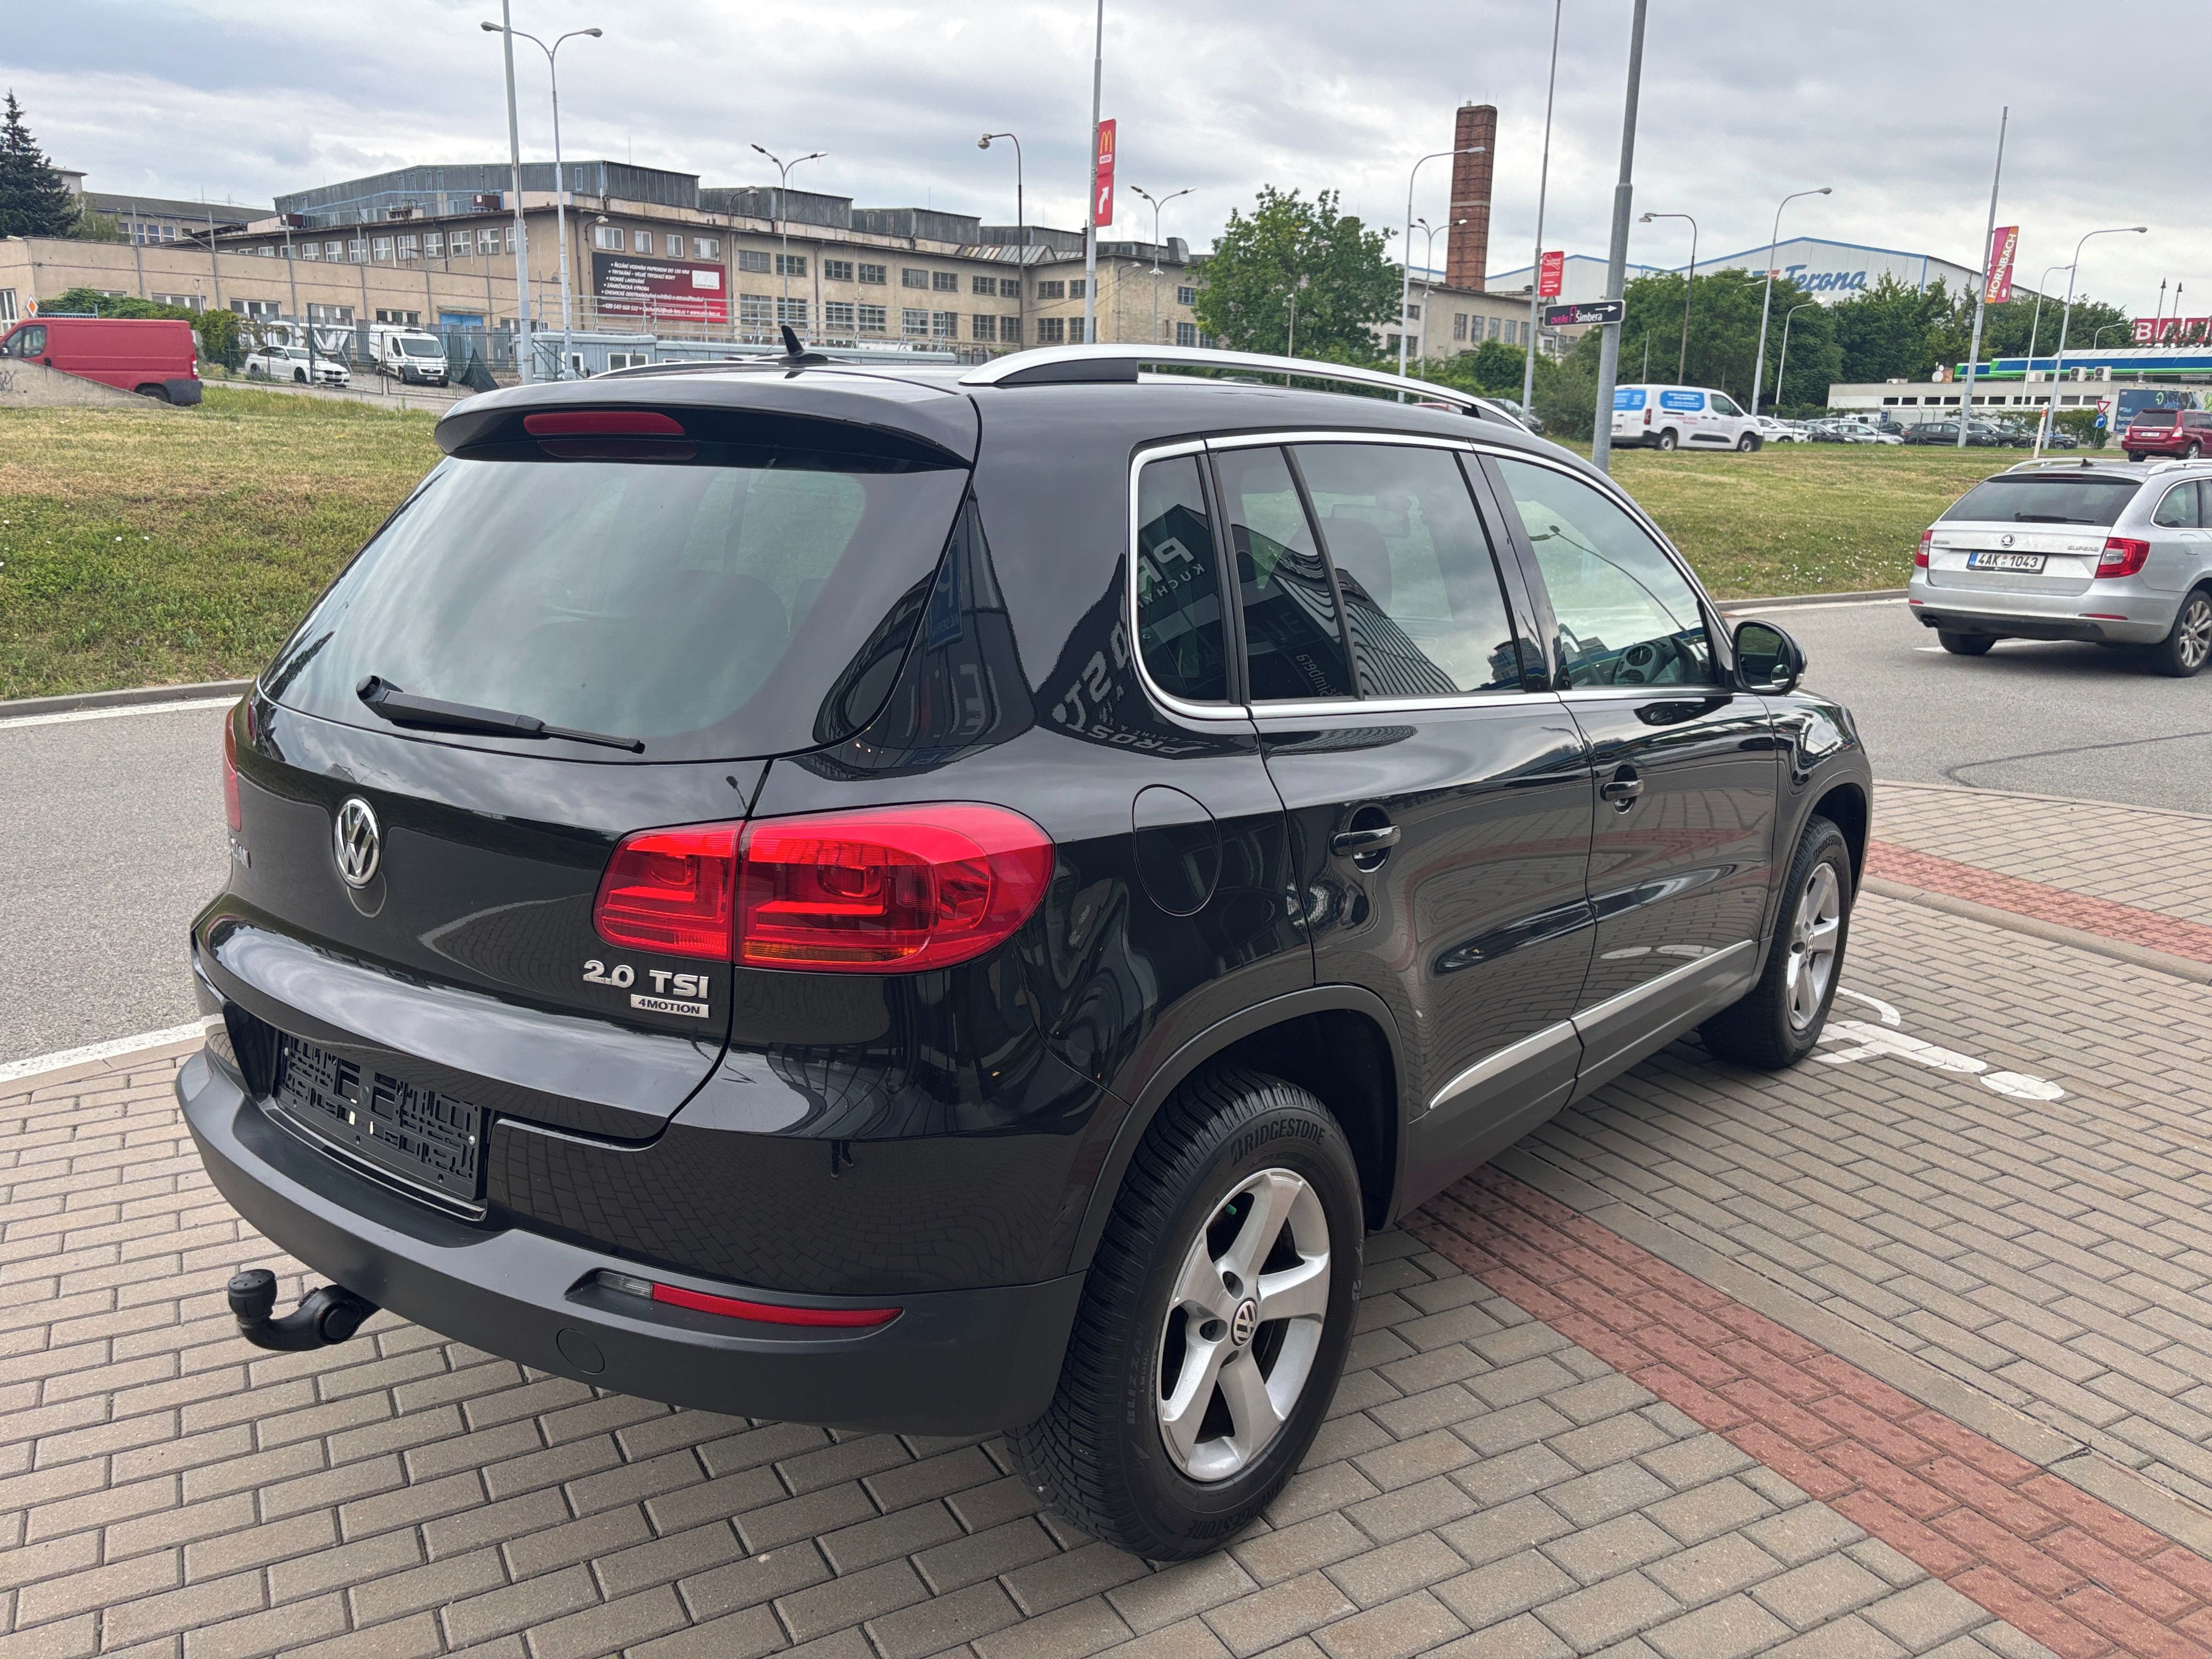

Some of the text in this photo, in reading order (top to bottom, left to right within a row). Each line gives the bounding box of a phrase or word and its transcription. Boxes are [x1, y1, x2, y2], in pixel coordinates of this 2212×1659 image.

[1987, 233, 2017, 298] HORNBACH
[1576, 310, 1602, 323] Šimbera
[1978, 553, 2001, 566] 4AK
[2010, 555, 2038, 568] 1043
[583, 960, 709, 998] 2.0 TSI
[638, 998, 700, 1014] 4MOTION
[1230, 1118, 1325, 1167] BRIDGESTONE
